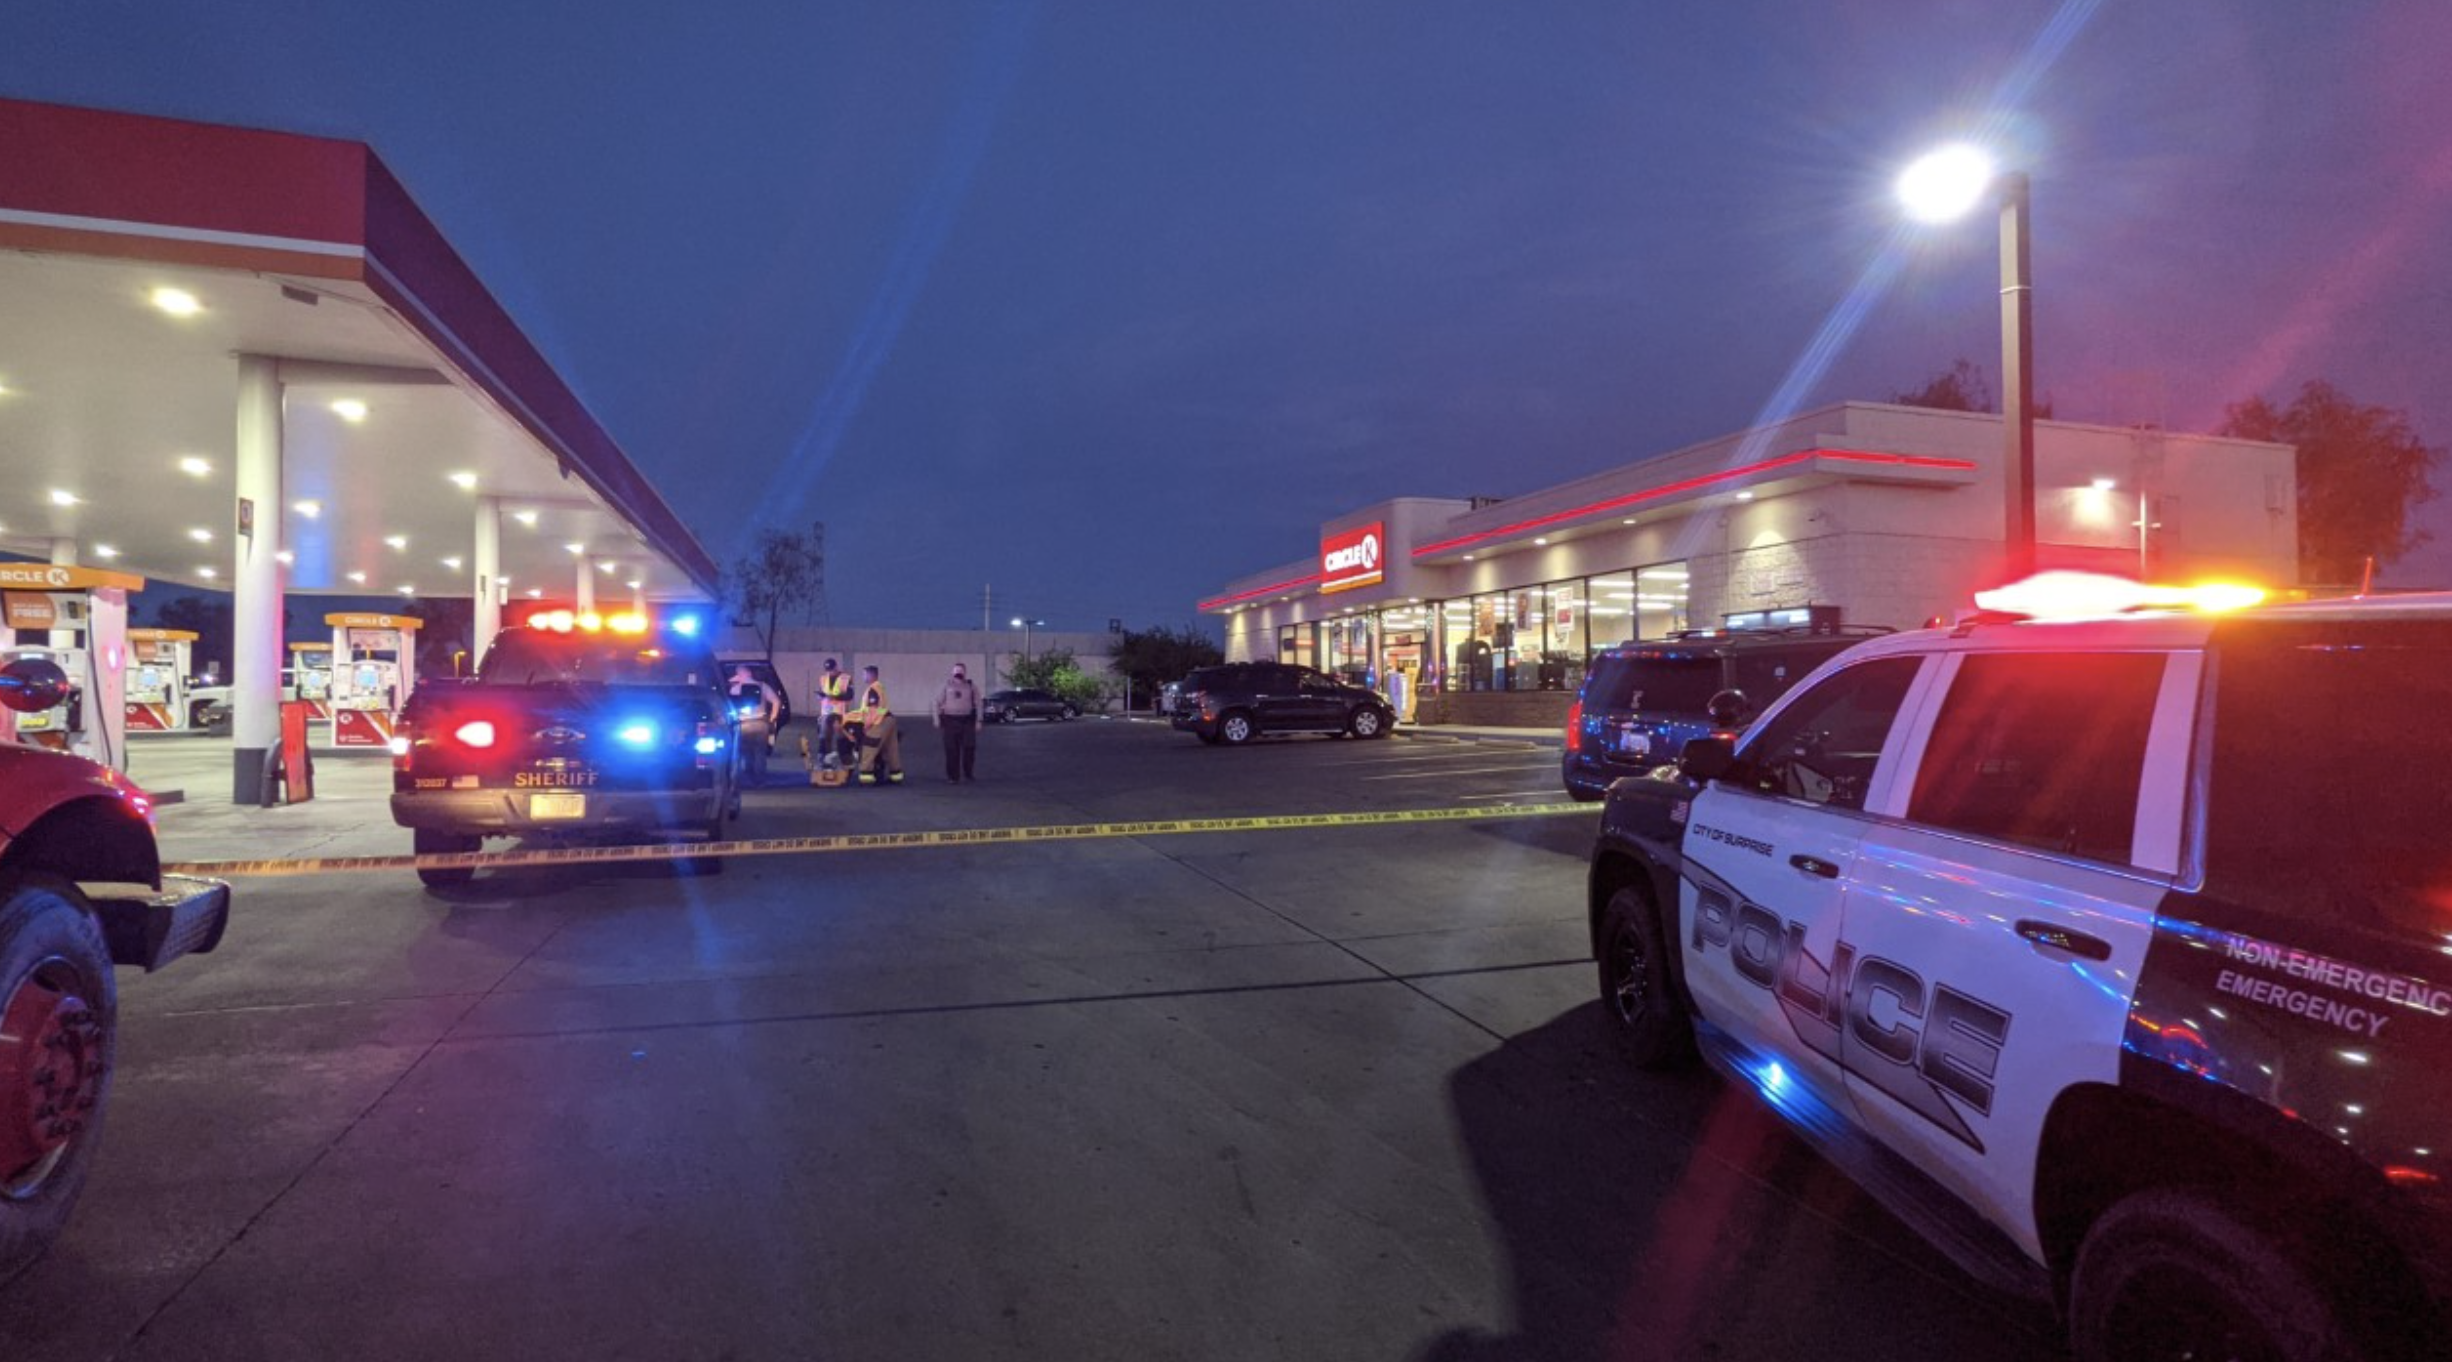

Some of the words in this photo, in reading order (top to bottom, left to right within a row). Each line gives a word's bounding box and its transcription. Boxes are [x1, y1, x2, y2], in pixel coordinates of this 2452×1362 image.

[1325, 544, 1362, 573] CIRCLE
[1362, 534, 1378, 569] K
[46, 568, 70, 586] K
[515, 772, 599, 787] SHERIFF
[1693, 823, 1711, 838] CITY
[1711, 829, 1725, 841] OF
[1724, 832, 1774, 857] SURPRISE
[1691, 885, 2013, 1117] POLICE
[2215, 969, 2390, 1038] EMERGENCY
